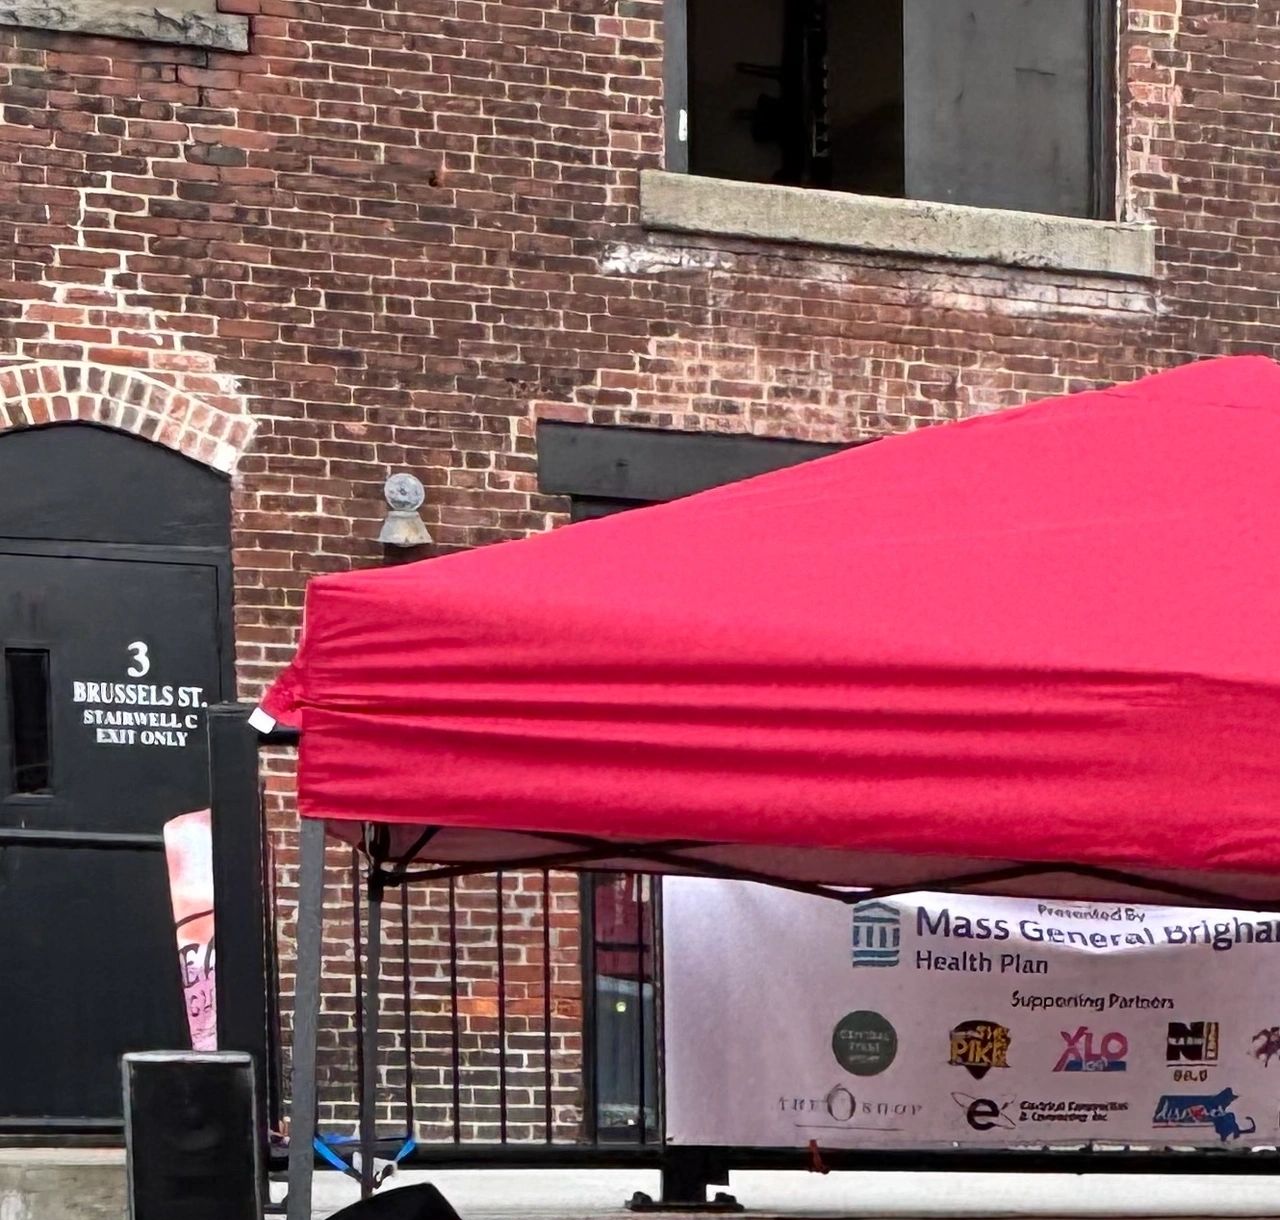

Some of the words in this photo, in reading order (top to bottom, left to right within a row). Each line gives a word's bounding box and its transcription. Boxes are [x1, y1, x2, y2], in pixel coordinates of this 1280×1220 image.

[127, 641, 151, 678] 3
[73, 681, 173, 706] BRUSSELS
[178, 687, 207, 708] ST.
[83, 709, 182, 729] STAIRWELL
[185, 715, 198, 730] C
[96, 729, 136, 745] EXIT
[141, 731, 188, 747] ONLY
[916, 906, 1010, 941] Mass
[1019, 919, 1155, 948] General
[915, 949, 992, 974] Health
[1000, 954, 1049, 975] Plan
[1011, 990, 1104, 1011] Supporting
[1108, 993, 1175, 1010] Partners
[1052, 1025, 1129, 1072] XLO
